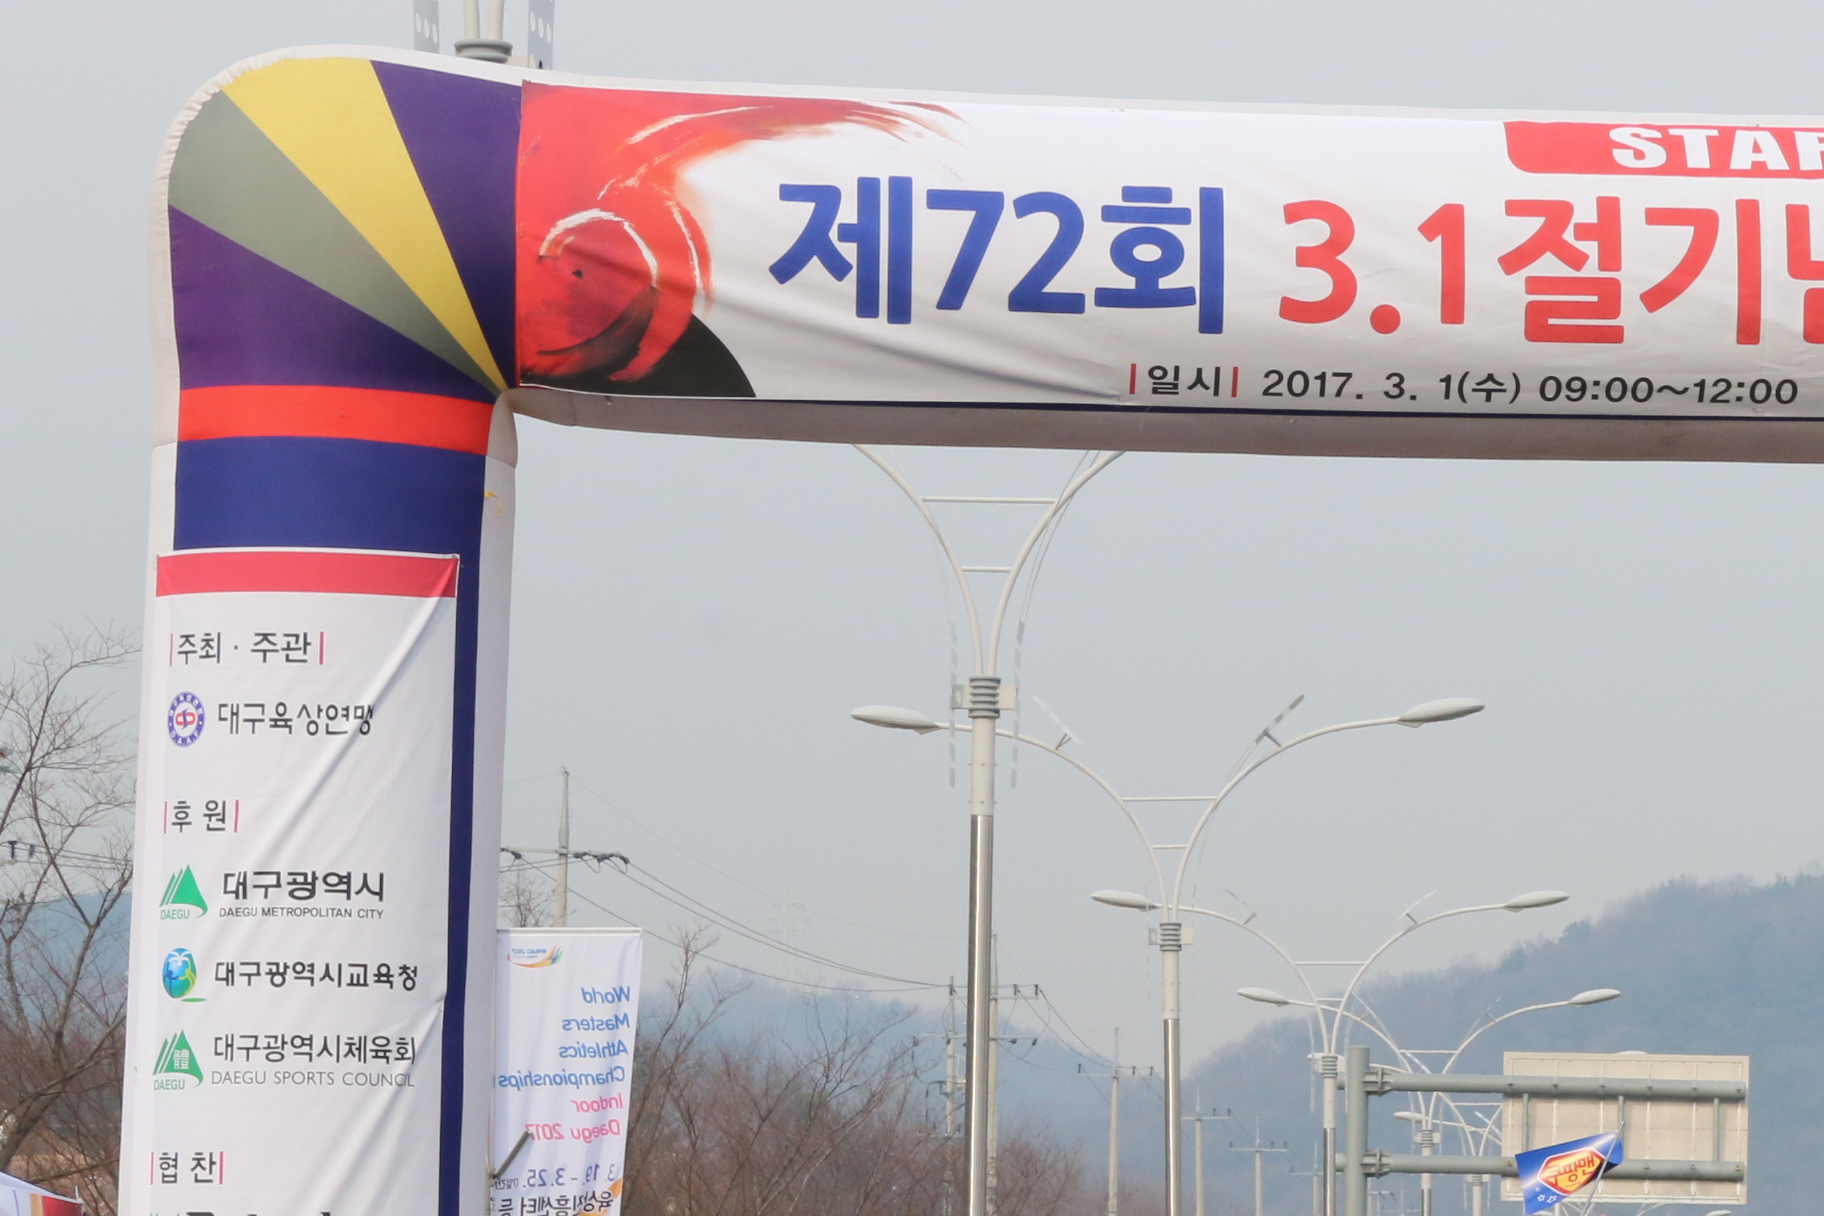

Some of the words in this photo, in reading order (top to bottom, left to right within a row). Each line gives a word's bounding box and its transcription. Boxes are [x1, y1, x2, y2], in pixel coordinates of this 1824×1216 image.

[768, 175, 1224, 334] 제72회
[1147, 364, 1222, 398] 일시
[1262, 370, 1365, 401] 2017.
[1439, 370, 1521, 405] 1(수)
[1539, 375, 1799, 405] 09:00~12:00
[177, 632, 221, 664] 주최
[250, 632, 311, 664] 주관
[217, 701, 375, 737] 대구육상연맹
[223, 870, 385, 903] 대구광역시
[160, 909, 190, 919] DAEGU
[218, 906, 258, 918] DAEGU
[261, 906, 353, 919] METROPOLITAN
[357, 908, 384, 919] CITY
[214, 961, 418, 991] 대구광역시교육청
[213, 1033, 417, 1066] 대구광역시체육회
[153, 1078, 185, 1090] DAEGU
[211, 1071, 266, 1085] DAEGU
[273, 1071, 335, 1086] SPORTS
[342, 1072, 415, 1088] COUNCIL
